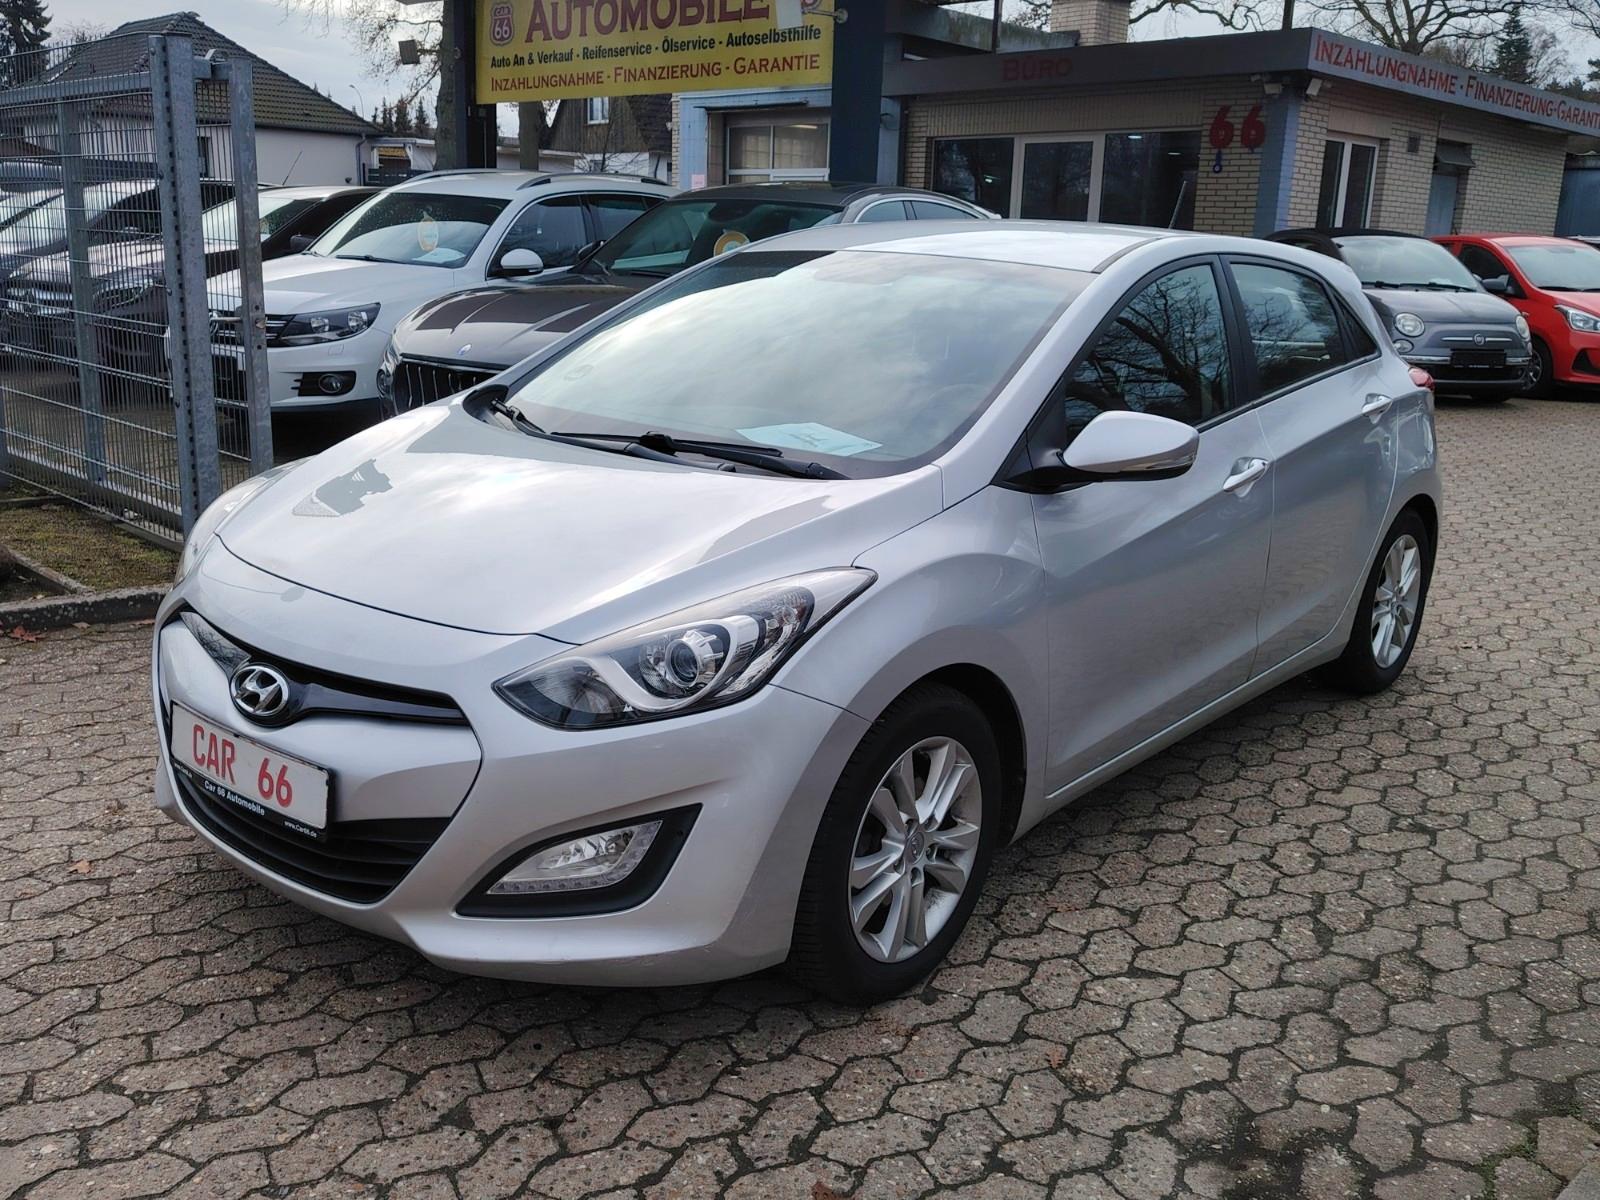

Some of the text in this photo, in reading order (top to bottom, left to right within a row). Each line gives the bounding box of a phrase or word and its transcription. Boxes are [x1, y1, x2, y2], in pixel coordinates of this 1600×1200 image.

[494, 18, 511, 39] 66
[495, 6, 511, 16] CAR
[524, 0, 770, 43] AUTOMOBILE
[490, 24, 822, 69] Auto An & Verkauf Reifenservice Ölservice Autoselbsthilfe
[490, 53, 821, 92] INZAHLUNGNAHME FINANZIERUNG GARANTIE
[1002, 53, 1073, 81] BÜRO
[1314, 33, 1458, 95] INZAHLUNGNAHME
[1465, 75, 1553, 118] FINANZIERUNG
[192, 724, 293, 807] CAR 66
[204, 780, 216, 793] Car
[227, 791, 265, 816] Automobile
